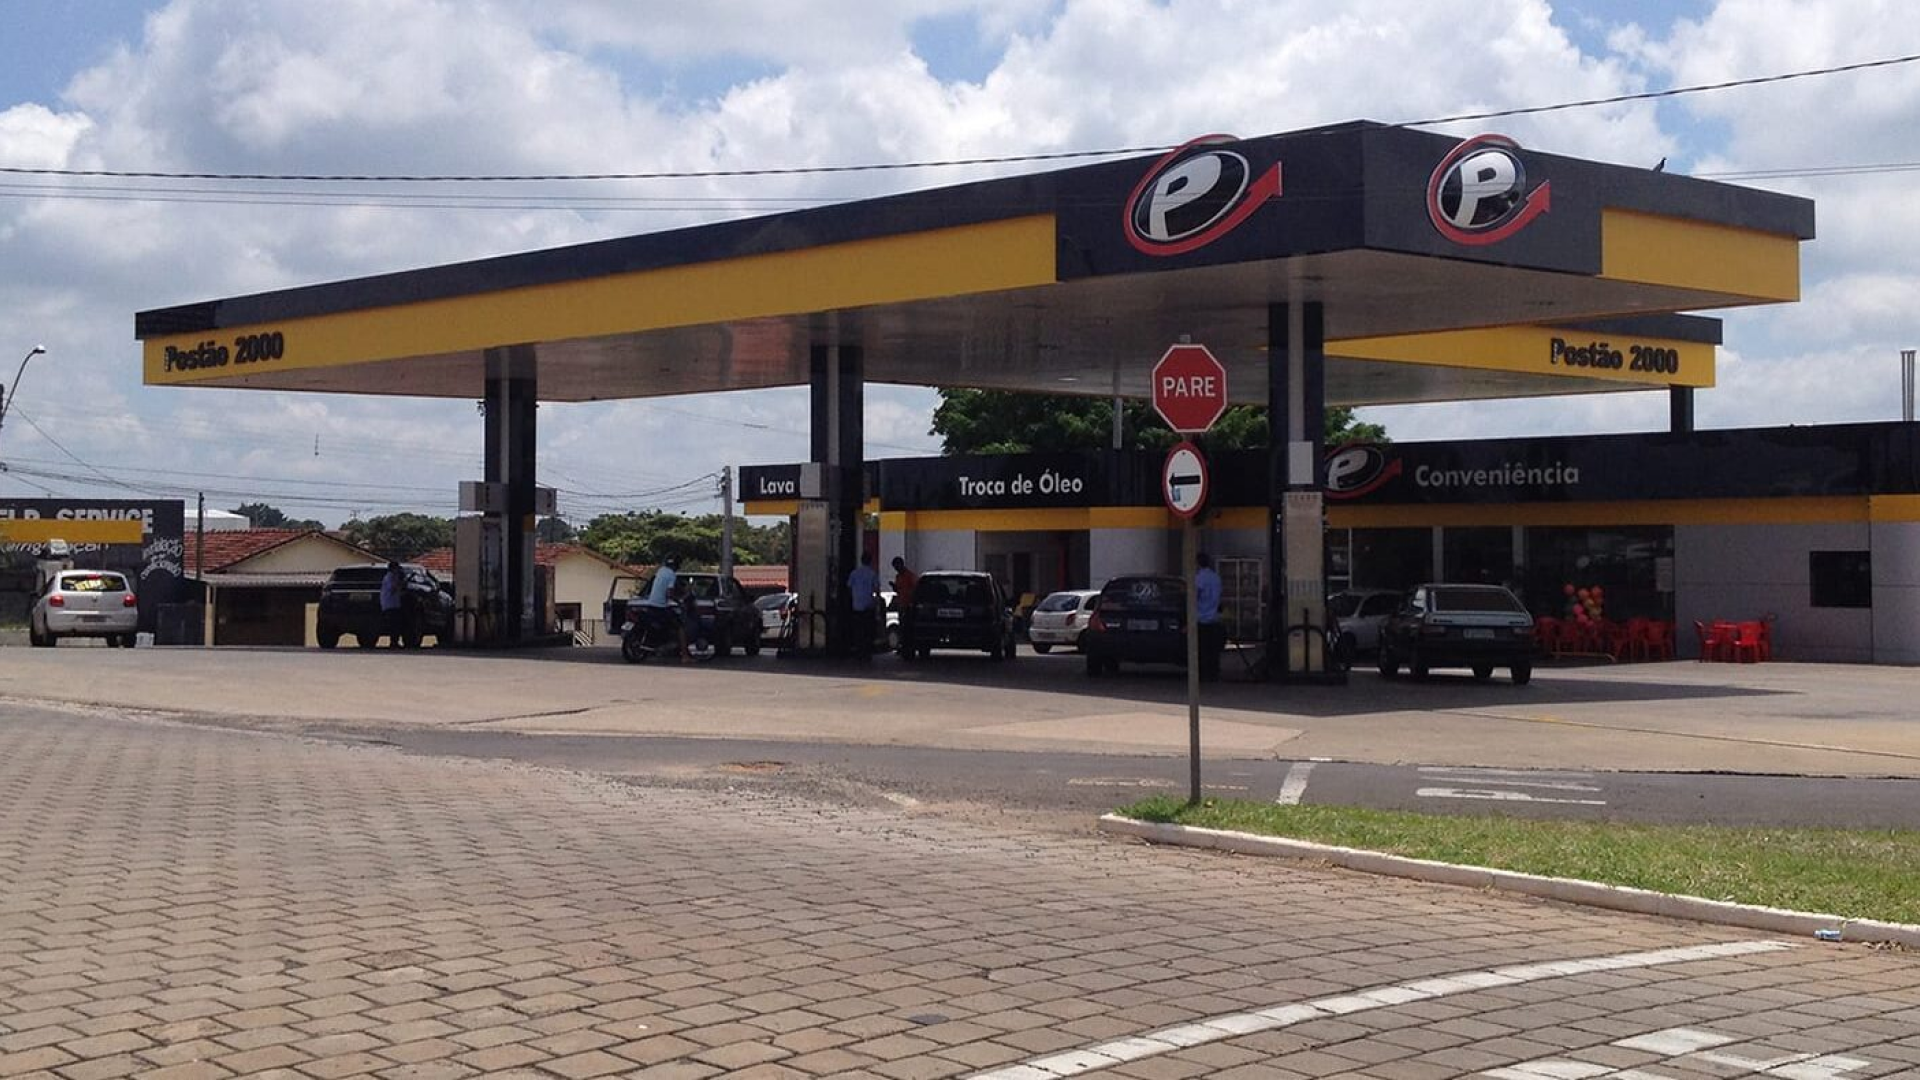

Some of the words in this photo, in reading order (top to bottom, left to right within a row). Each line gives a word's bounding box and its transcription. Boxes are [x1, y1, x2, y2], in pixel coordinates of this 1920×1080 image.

[164, 340, 229, 372] Postão
[234, 331, 284, 365] 2000
[1550, 337, 1624, 371] Postão
[1629, 345, 1679, 374] 2000
[1162, 376, 1217, 398] PARE
[760, 476, 795, 495] Lava
[959, 476, 1006, 496] Troca
[1011, 472, 1034, 495] de
[1039, 468, 1083, 494] Óleo
[1415, 461, 1580, 487] Conveniência
